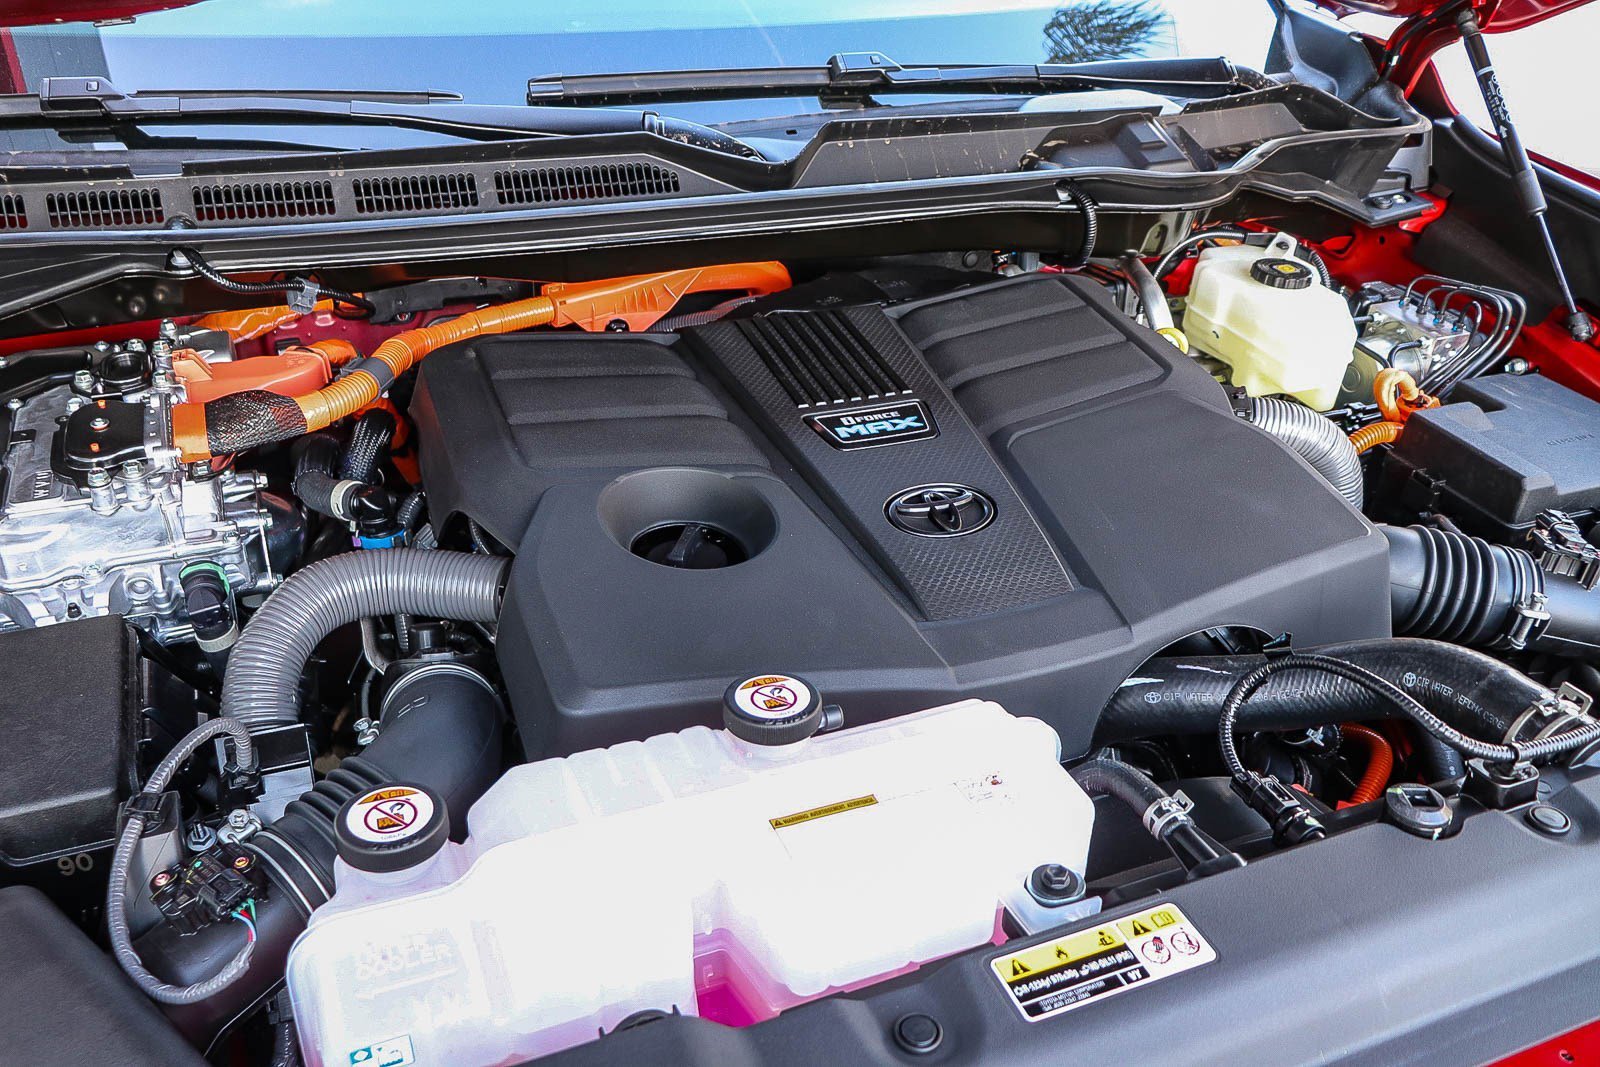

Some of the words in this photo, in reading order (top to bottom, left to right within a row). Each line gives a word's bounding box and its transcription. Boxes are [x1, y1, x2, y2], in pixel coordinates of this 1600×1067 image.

[834, 416, 924, 438] MAX
[782, 813, 809, 824] WARNING
[57, 853, 93, 876] 90
